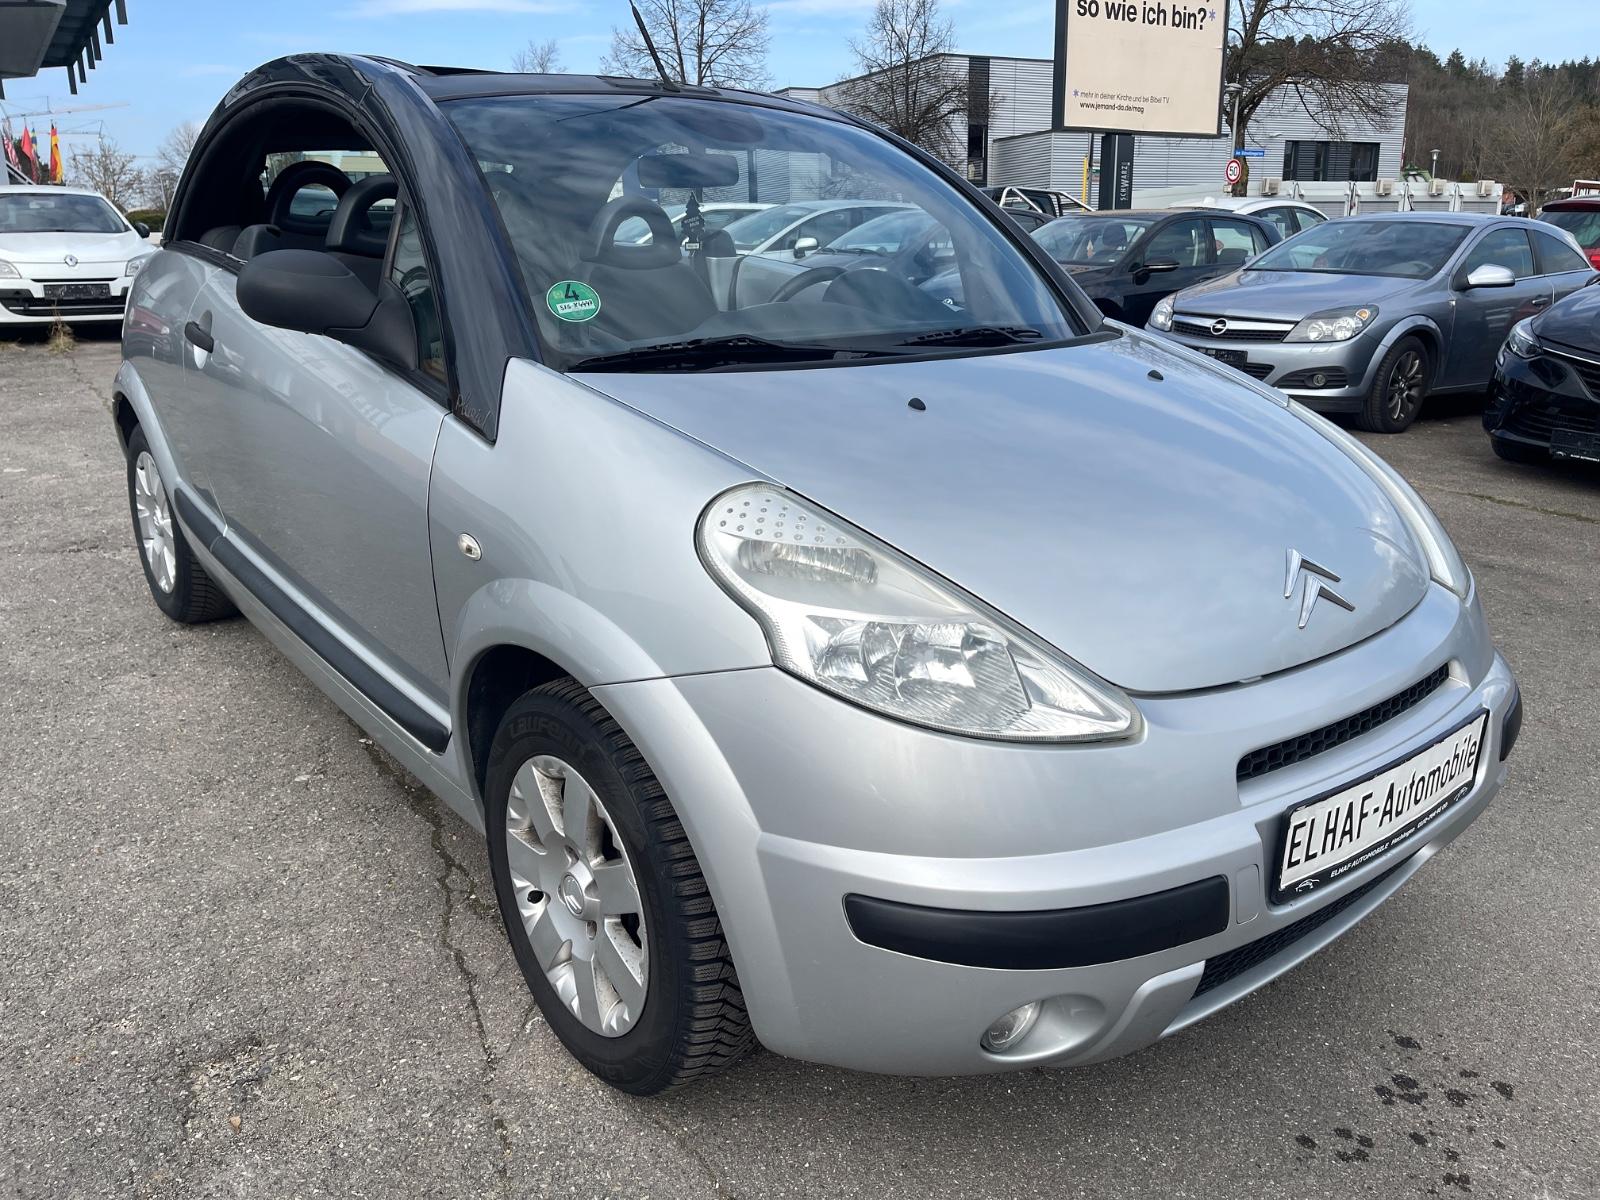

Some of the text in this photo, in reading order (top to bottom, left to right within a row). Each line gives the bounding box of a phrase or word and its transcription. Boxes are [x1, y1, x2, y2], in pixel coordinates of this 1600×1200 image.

[1076, 0, 1100, 18] so
[1105, 0, 1138, 22] wie
[1142, 1, 1167, 26] ich
[1100, 92, 1116, 100] deiner
[1117, 93, 1132, 101] Kirche
[1229, 165, 1238, 176] 50
[1120, 165, 1129, 201] SCHWARZ
[565, 284, 579, 300] 4
[1287, 730, 1478, 870] ELHAF-Automobile
